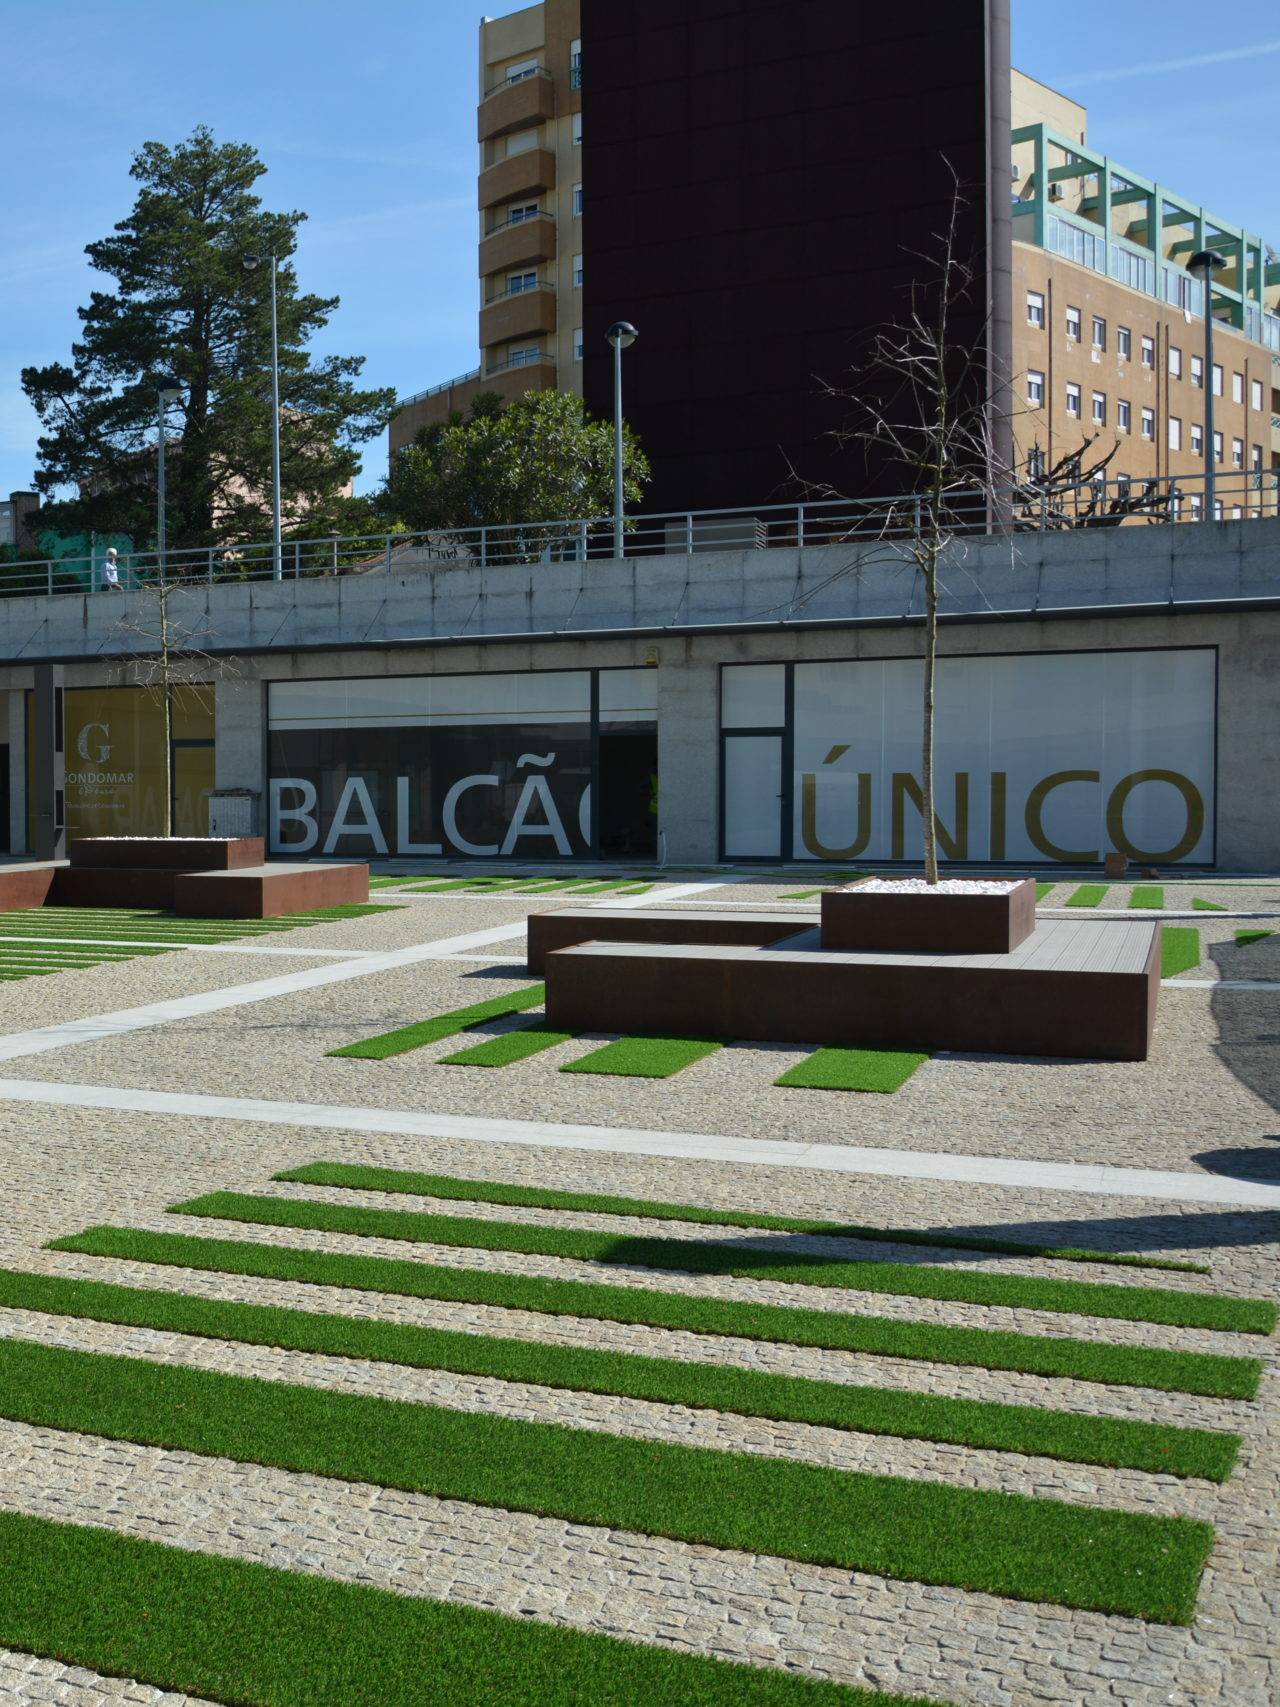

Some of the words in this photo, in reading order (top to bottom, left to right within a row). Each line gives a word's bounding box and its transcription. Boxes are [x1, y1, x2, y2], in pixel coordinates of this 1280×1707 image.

[77, 722, 114, 763] G
[269, 751, 592, 856] BALCÃ
[801, 744, 1205, 863] ÚNICO
